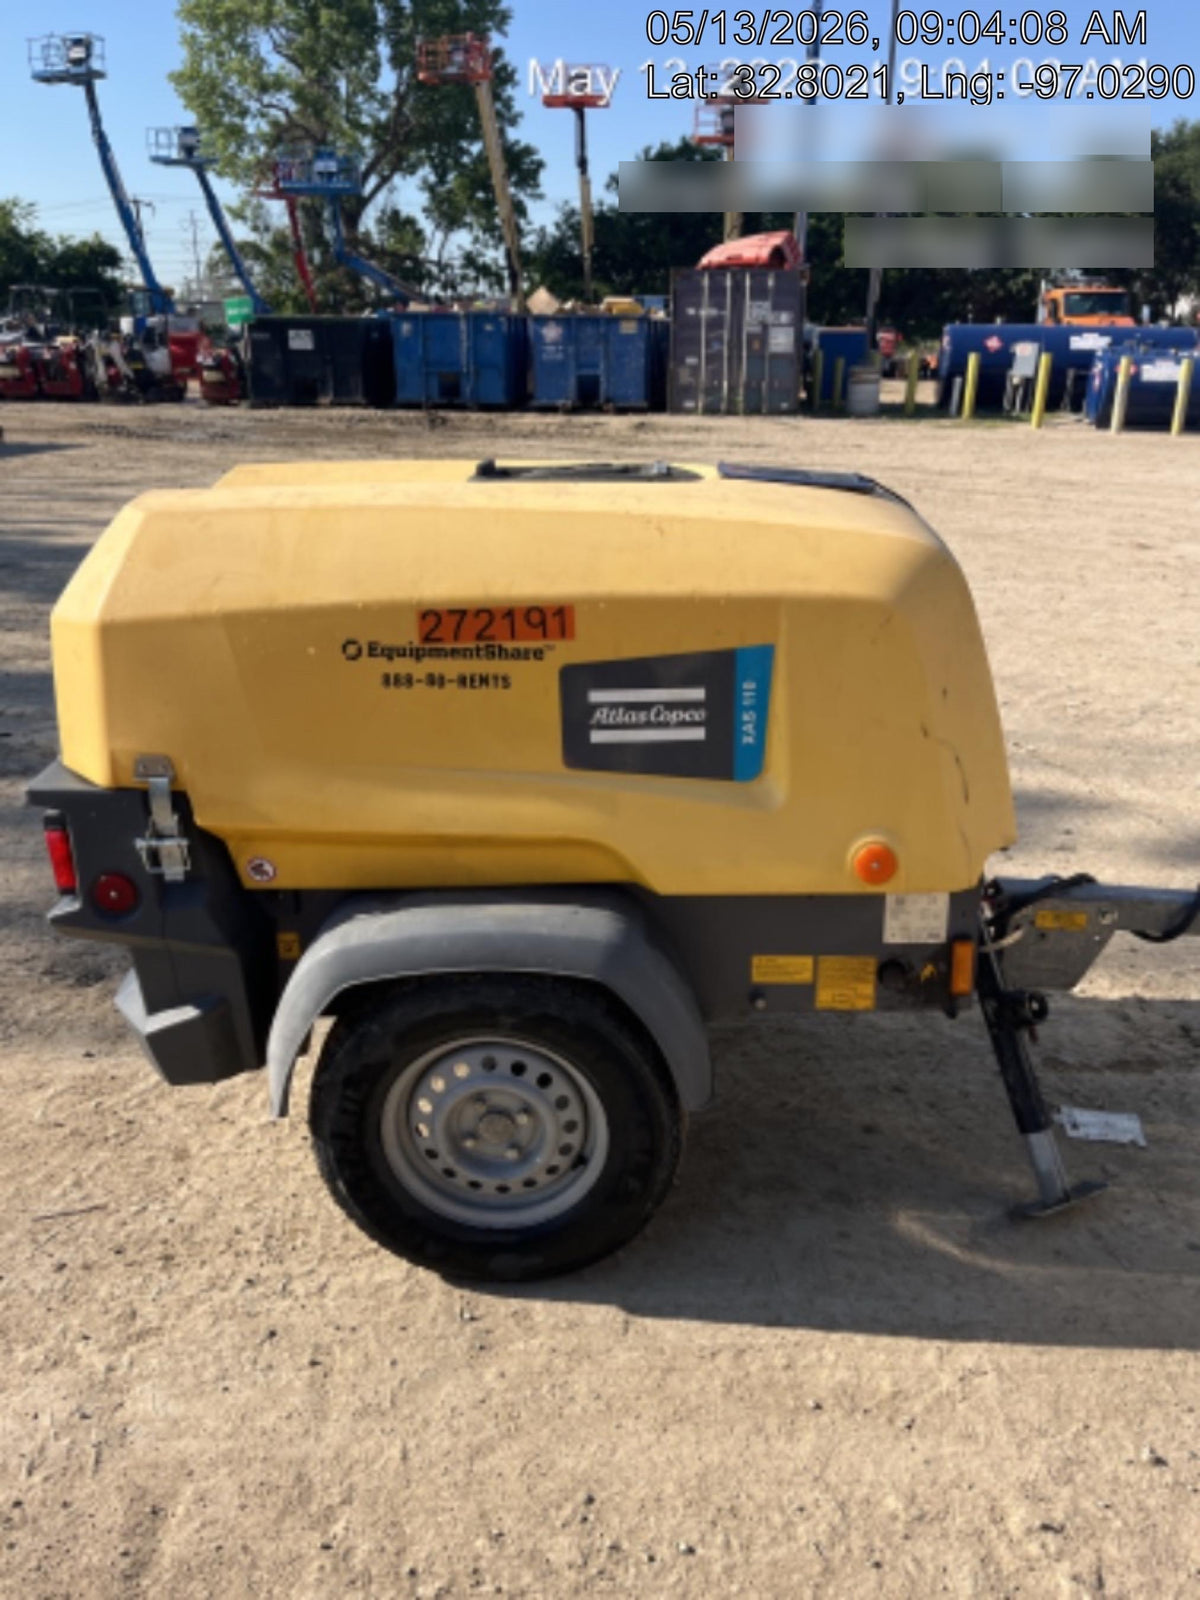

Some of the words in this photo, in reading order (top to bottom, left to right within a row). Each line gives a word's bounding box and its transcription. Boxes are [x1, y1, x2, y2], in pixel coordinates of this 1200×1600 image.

[420, 607, 569, 642] 272191
[590, 706, 648, 725] Atlas
[649, 704, 707, 726] Copco
[742, 711, 757, 745] XAS
